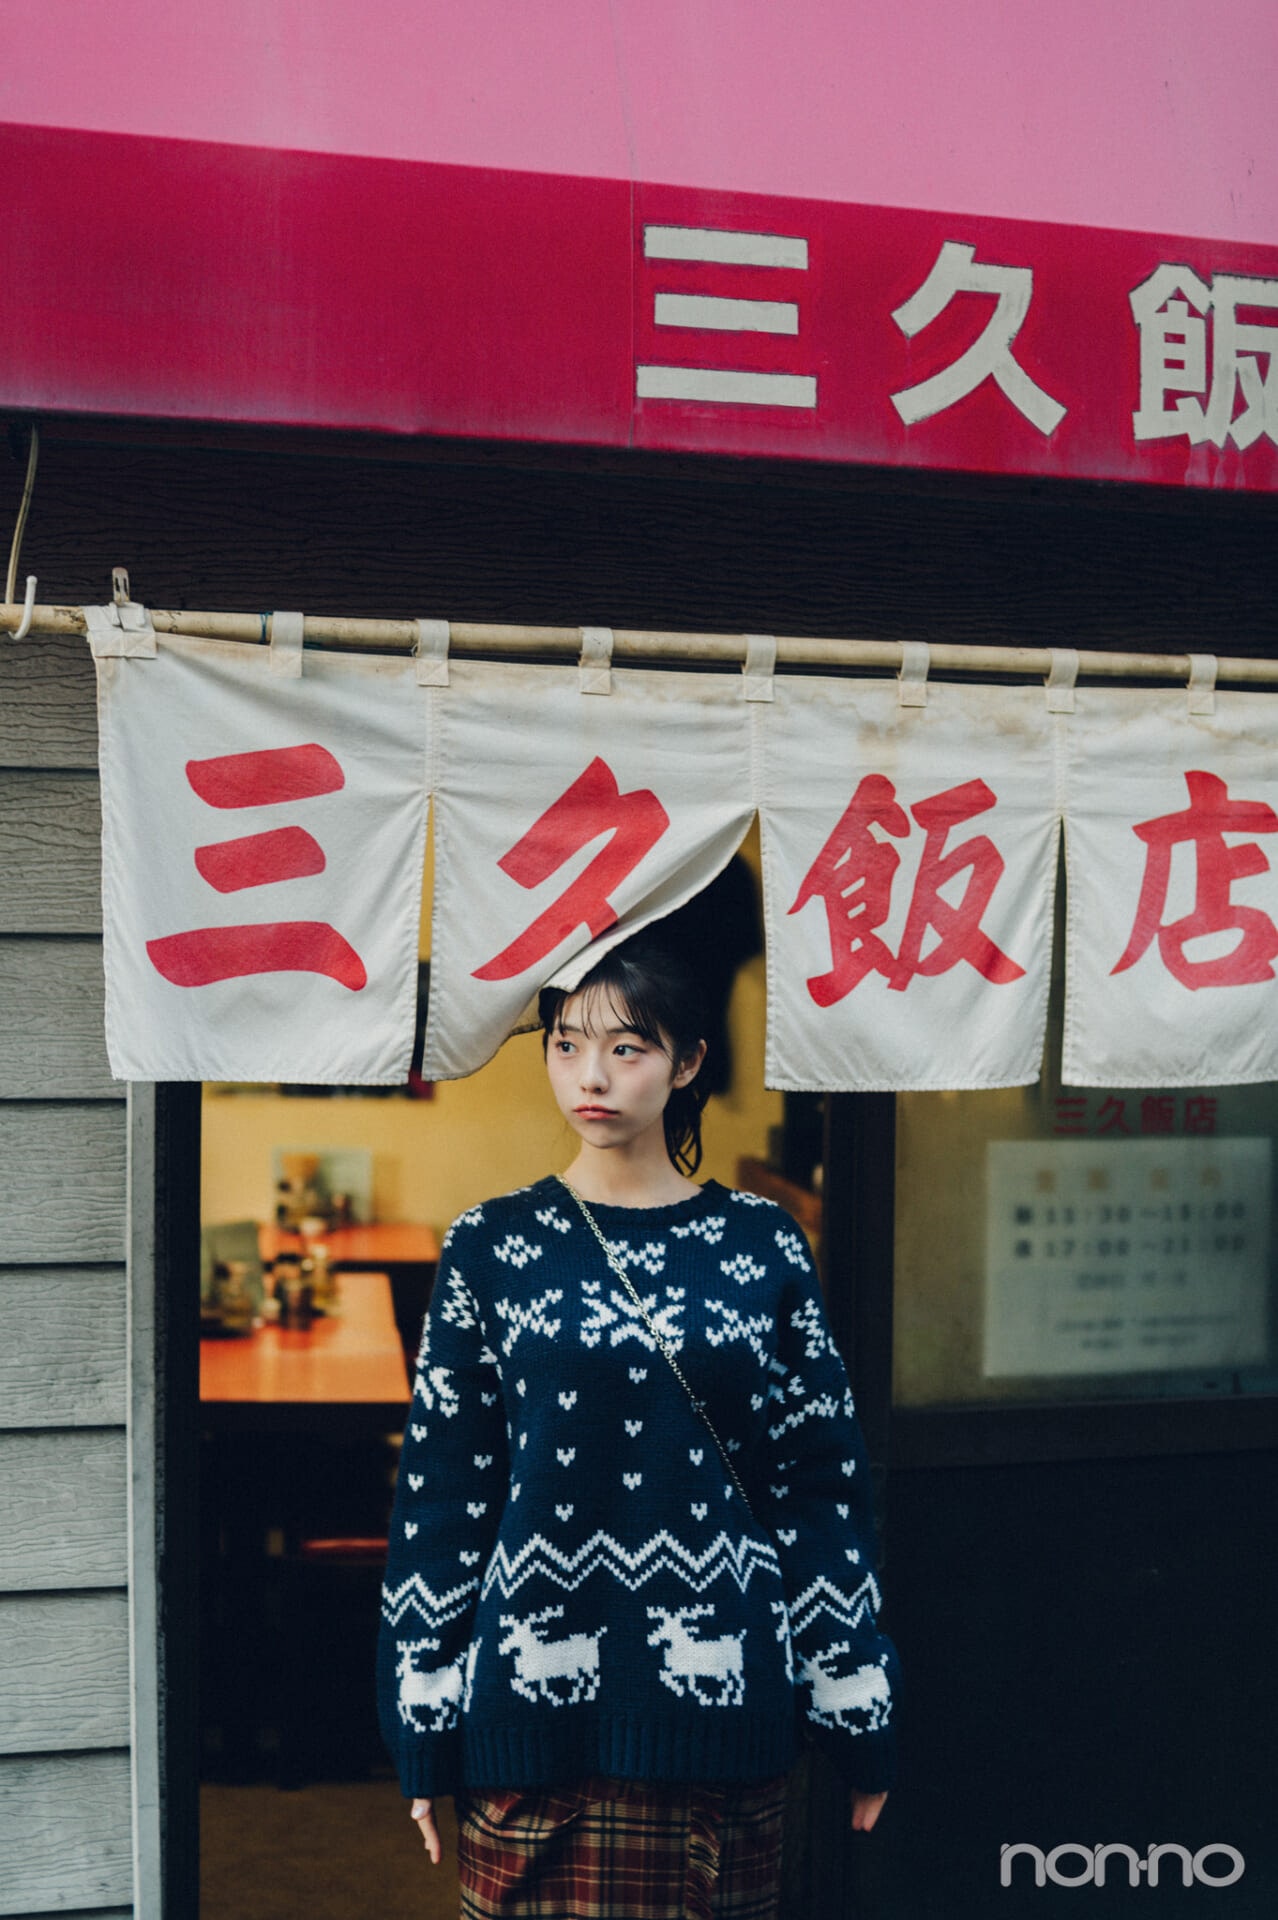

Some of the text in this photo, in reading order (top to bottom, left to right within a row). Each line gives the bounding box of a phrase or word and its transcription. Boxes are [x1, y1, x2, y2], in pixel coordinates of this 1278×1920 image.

[146, 743, 1278, 1008] 三久飯店
[1053, 1094, 1218, 1134] 三久飯店
